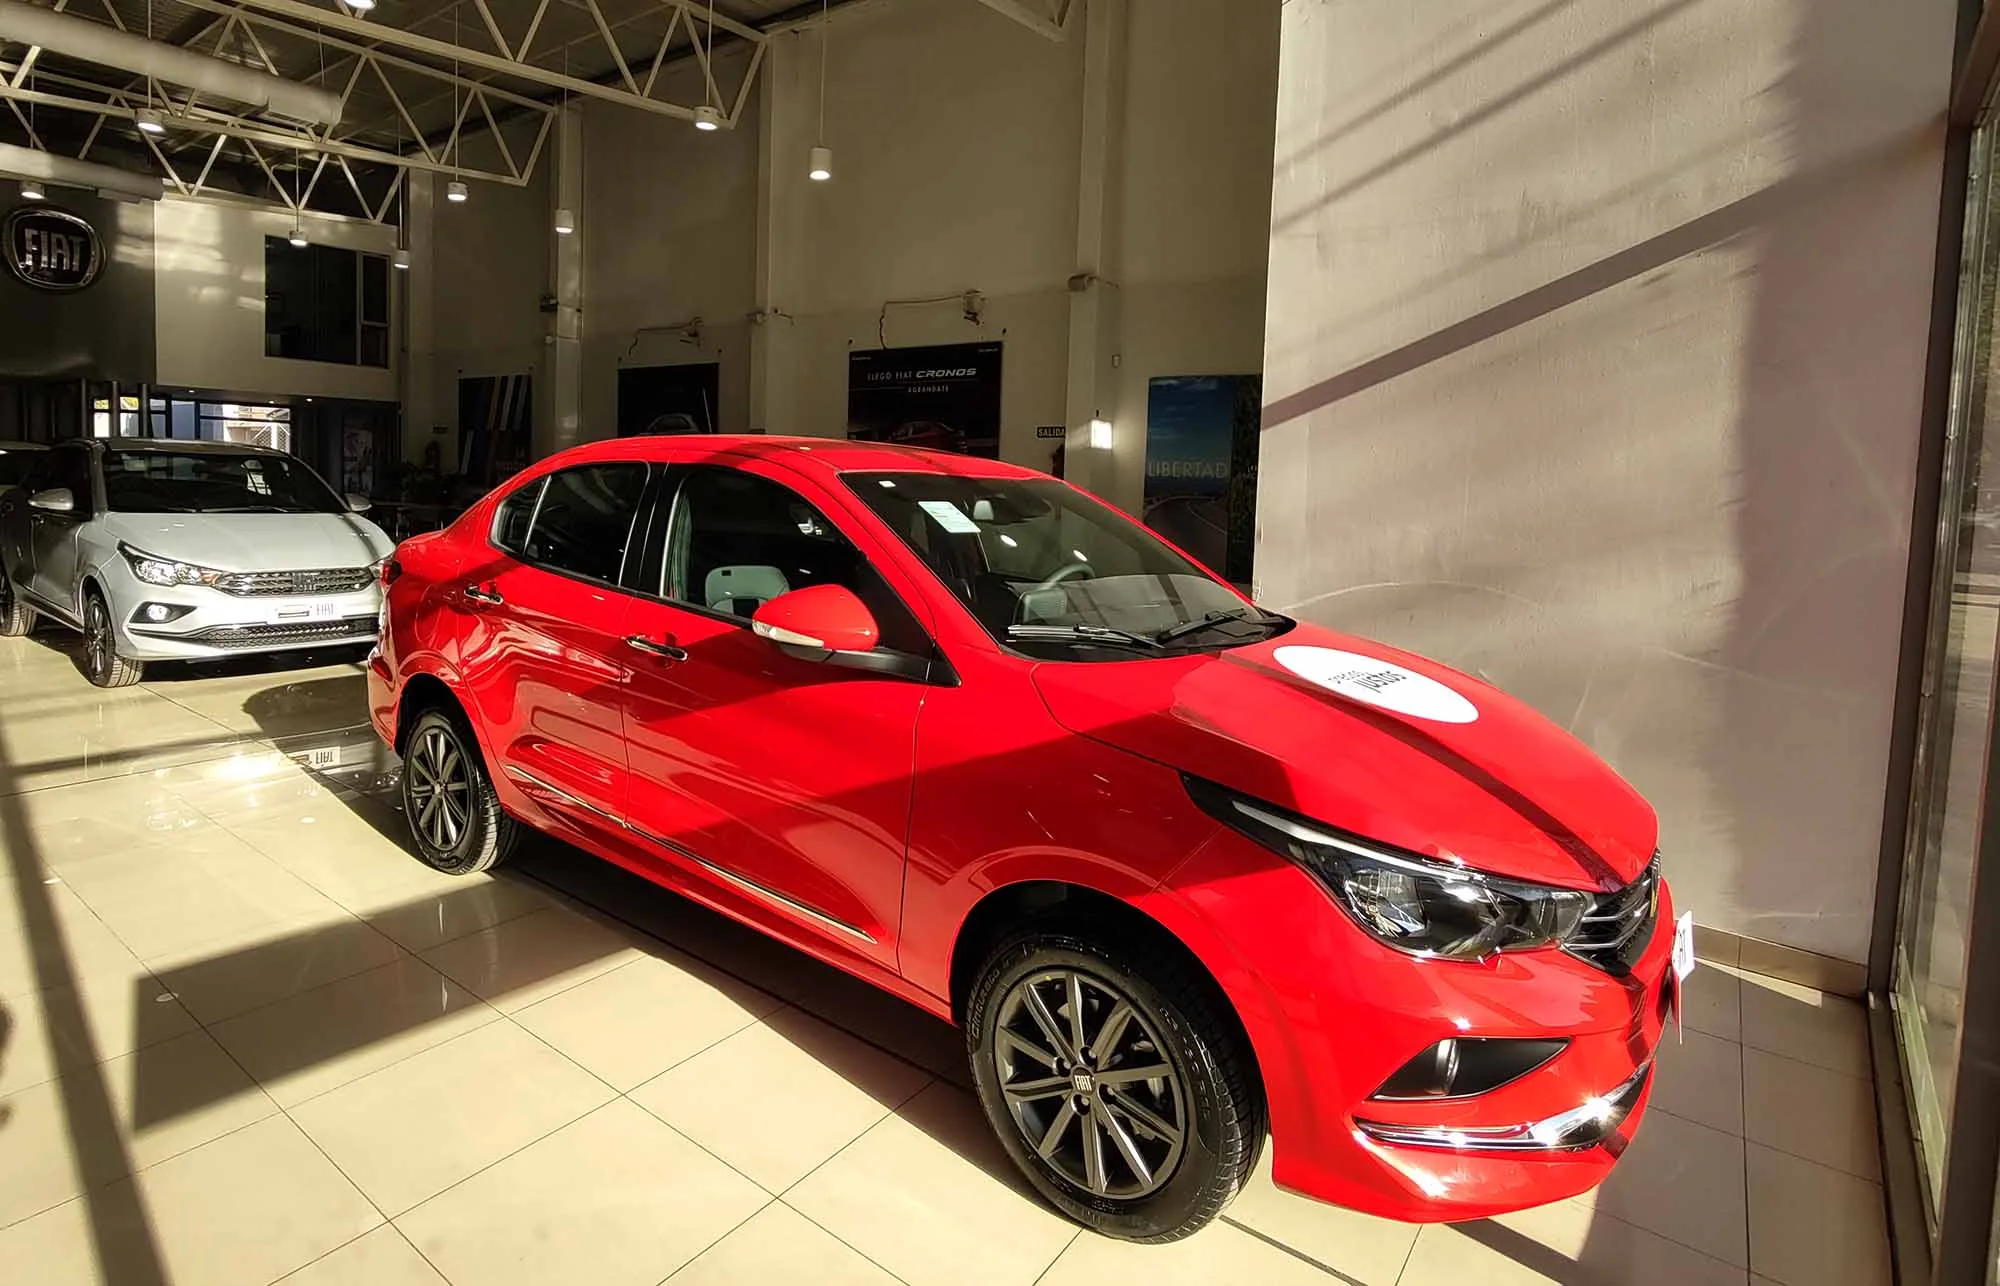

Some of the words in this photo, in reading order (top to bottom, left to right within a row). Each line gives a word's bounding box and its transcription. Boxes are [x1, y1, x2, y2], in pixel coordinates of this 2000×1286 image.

[24, 228, 86, 272] FIAT
[915, 367, 977, 379] CRONOS
[1038, 427, 1065, 437] SALIDA
[1148, 460, 1227, 479] LIBERTAD
[1074, 1074, 1092, 1091] FIAT
